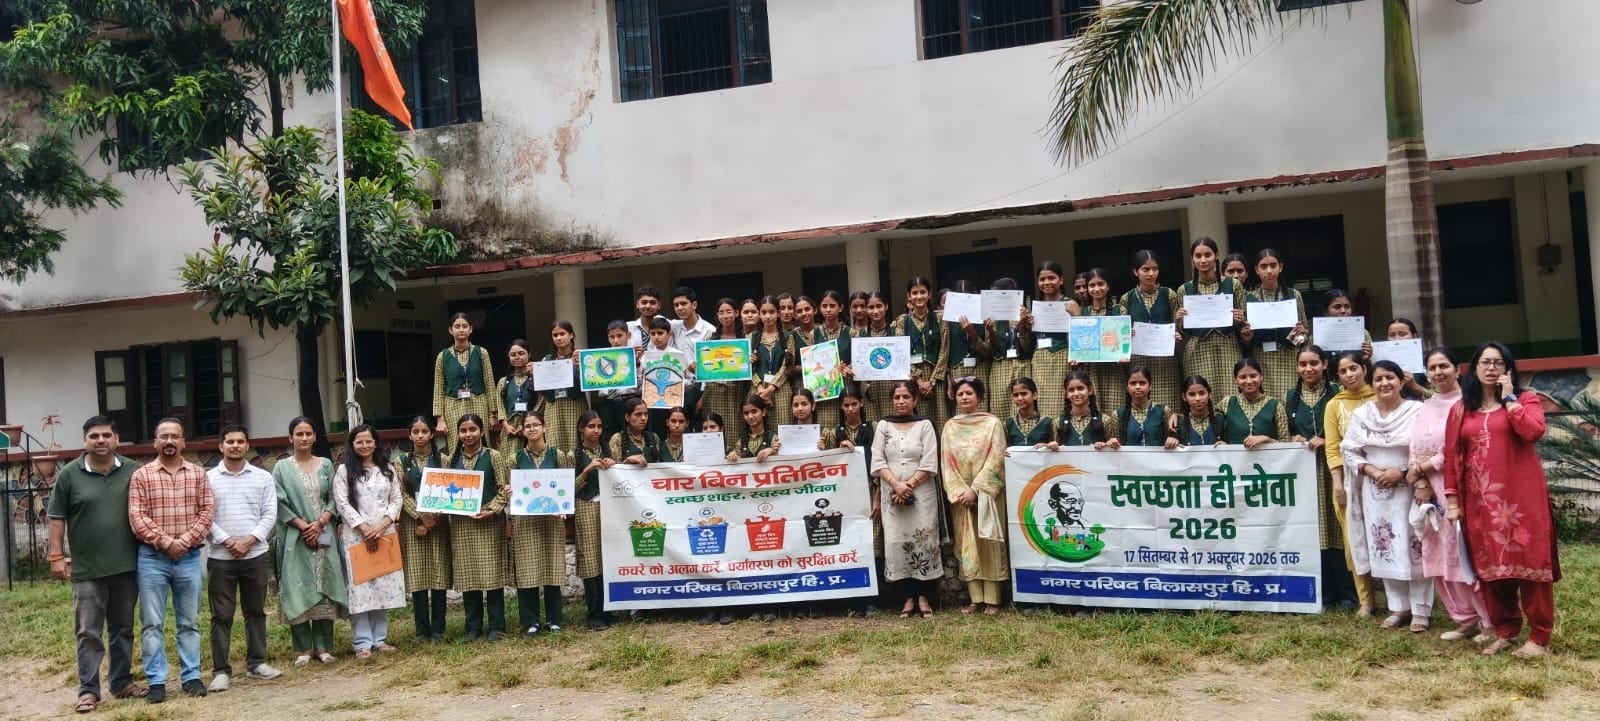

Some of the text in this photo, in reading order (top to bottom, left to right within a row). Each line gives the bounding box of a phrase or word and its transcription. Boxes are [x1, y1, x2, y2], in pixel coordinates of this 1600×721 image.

[651, 461, 848, 492] चार बिन प्रतिदिन
[1107, 463, 1298, 509] स्वच्छता ही सेवा
[665, 493, 705, 505] स्वच्छ
[793, 483, 838, 496] जीवन
[1169, 517, 1237, 540] 2026
[618, 563, 645, 577] कचरे
[649, 562, 664, 575] को
[668, 564, 698, 575] अलग
[728, 558, 773, 572] पर्यावरण
[777, 556, 792, 569] को
[796, 553, 835, 570] सुरक्षित
[839, 549, 858, 563] करें
[1124, 546, 1300, 570] 17 सितम्बर से 17 अक्टूबर 2026 तक
[633, 585, 672, 596] नगर
[673, 582, 722, 594] परिषद
[725, 578, 799, 593] बिलासपुर
[1040, 577, 1085, 590] नगर
[1085, 575, 1139, 591] परिषद
[1143, 577, 1229, 597] बिलासपुर
